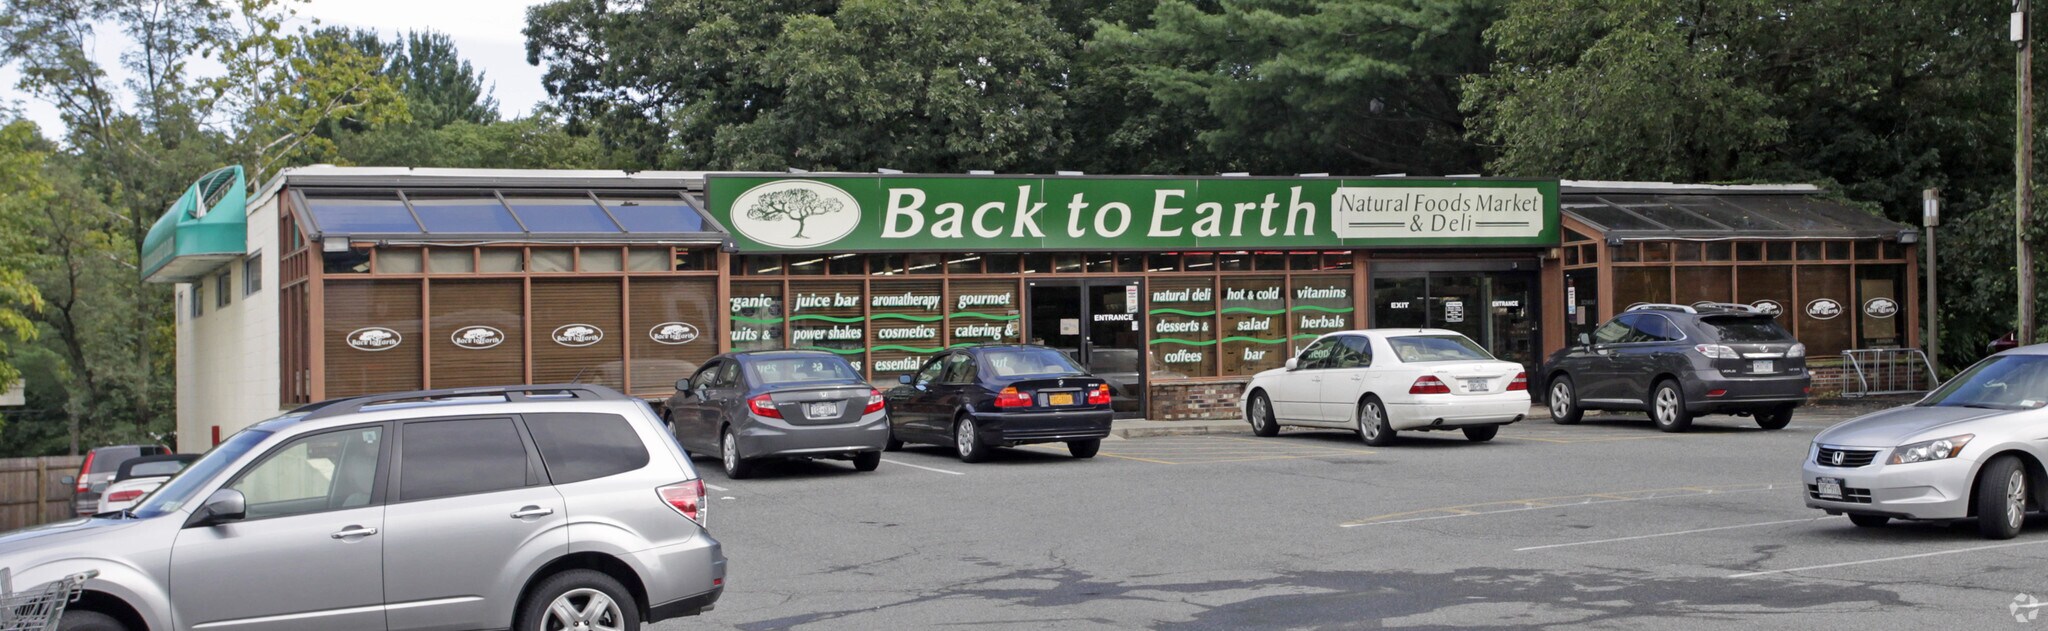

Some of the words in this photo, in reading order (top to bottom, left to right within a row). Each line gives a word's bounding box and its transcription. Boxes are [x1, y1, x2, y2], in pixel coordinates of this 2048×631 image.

[1338, 193, 1410, 213] Natural
[1414, 193, 1472, 213] Foods
[1475, 193, 1538, 213] Market
[880, 184, 1048, 239] Back
[1066, 192, 1132, 239] to
[1146, 185, 1317, 238] Earth
[1410, 214, 1424, 233] &
[1431, 213, 1473, 233] Deli
[1152, 287, 1190, 303] natural
[1191, 287, 1212, 302] deli
[1226, 287, 1246, 301] hot
[1247, 290, 1255, 300] &
[1256, 286, 1280, 301] cold
[1297, 285, 1347, 299] vitamins
[793, 292, 830, 312] juice
[834, 291, 860, 308] bar
[871, 291, 941, 311] aromatherapy
[957, 291, 1011, 310] gourmet
[1390, 301, 1410, 309] EXIT
[1492, 300, 1519, 308] ENTRANCE
[1094, 314, 1134, 322] ENTRANCE
[1236, 317, 1271, 331] salad
[1300, 314, 1345, 329] herbals
[877, 323, 936, 340] cosmetics
[954, 322, 1001, 341] catering
[1004, 323, 1015, 337] &
[1155, 319, 1200, 333] desserts
[1201, 321, 1209, 332] &
[761, 329, 771, 341] &
[792, 329, 826, 345] power
[827, 324, 862, 340] shakes
[1163, 349, 1203, 363] coffees
[1243, 347, 1266, 361] bar
[874, 356, 921, 371] essential
